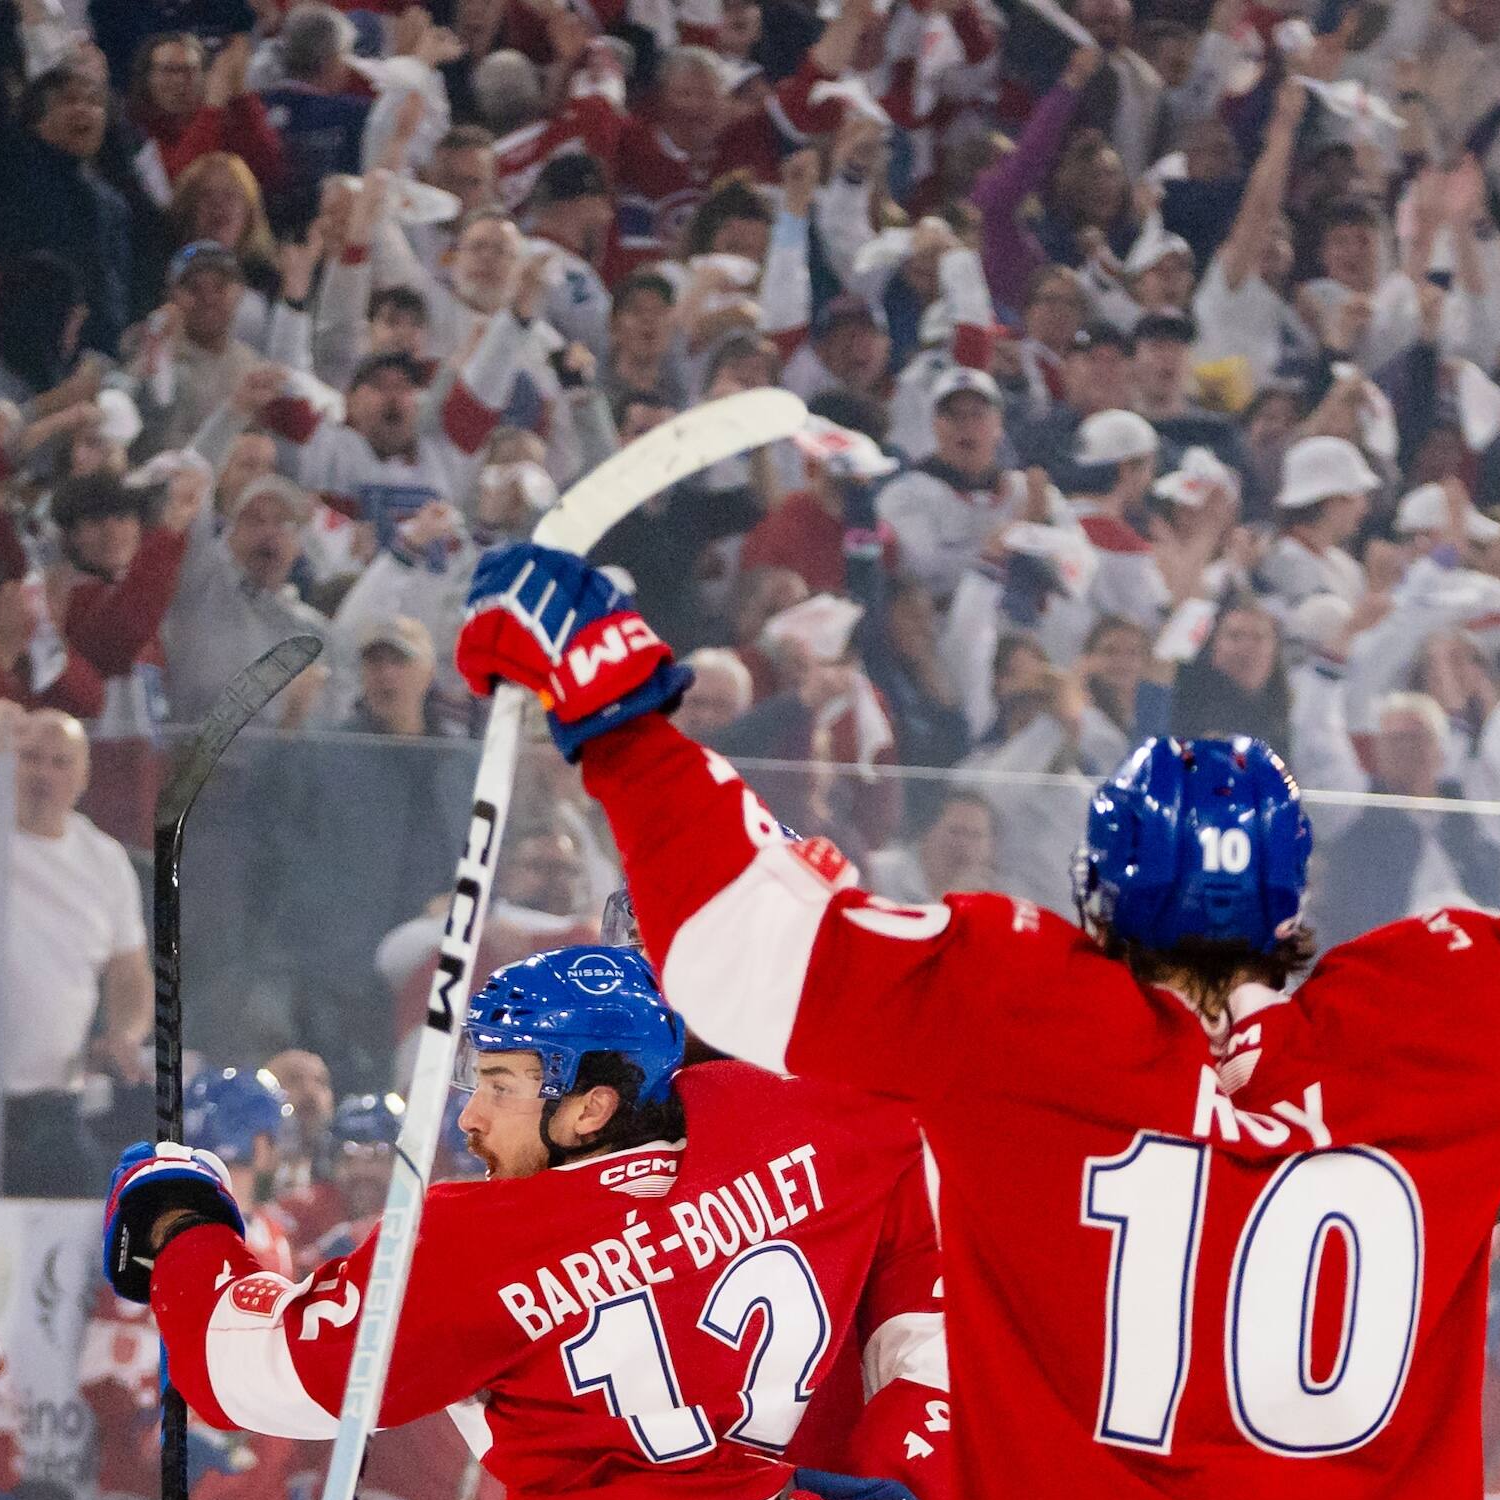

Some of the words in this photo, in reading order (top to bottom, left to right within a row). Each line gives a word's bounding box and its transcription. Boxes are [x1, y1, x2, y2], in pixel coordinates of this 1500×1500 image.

[567, 612, 662, 688] CM
[427, 798, 498, 1034] CCM
[1199, 826, 1252, 875] 10
[566, 967, 626, 979] NISSAN
[599, 1158, 678, 1186] CCM
[498, 1143, 825, 1342] BARRÉ-BOULET
[1081, 1128, 1422, 1459] 10
[559, 1238, 832, 1464] 12
